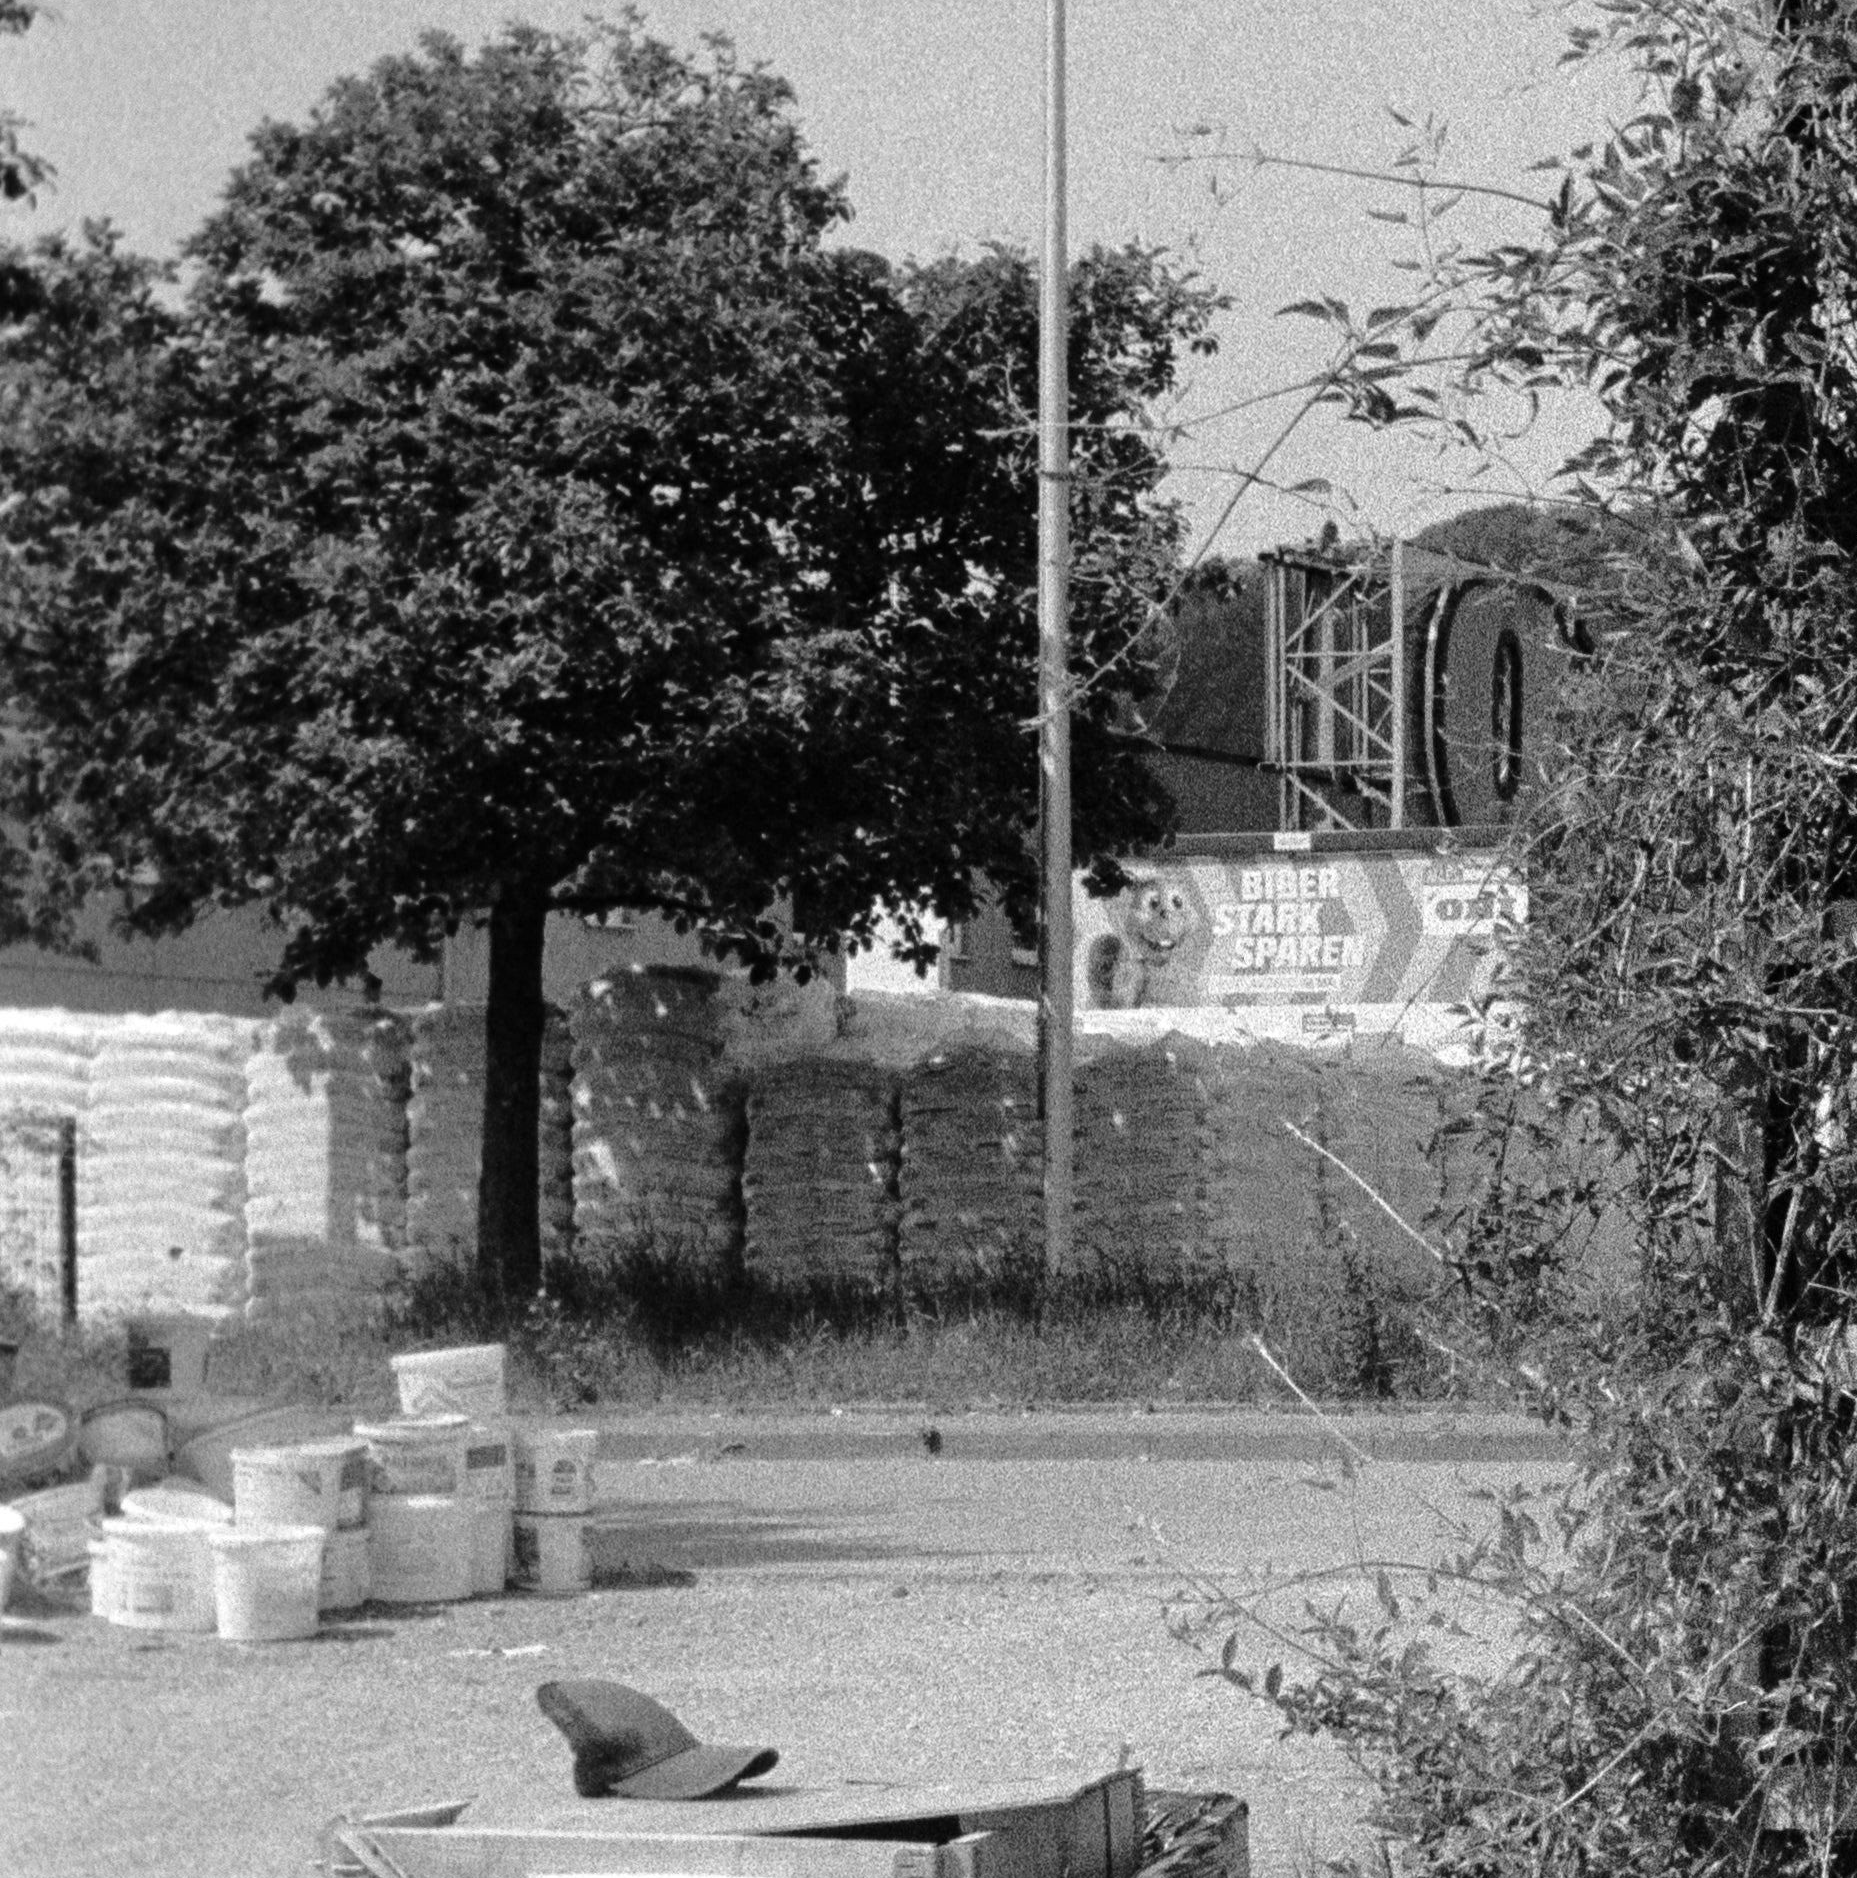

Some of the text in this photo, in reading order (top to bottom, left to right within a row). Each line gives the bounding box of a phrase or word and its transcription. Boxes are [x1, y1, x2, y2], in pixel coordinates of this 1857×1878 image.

[1240, 867, 1340, 900] BIBER
[1211, 901, 1324, 935] STARK
[1230, 935, 1365, 968] SPAREN
